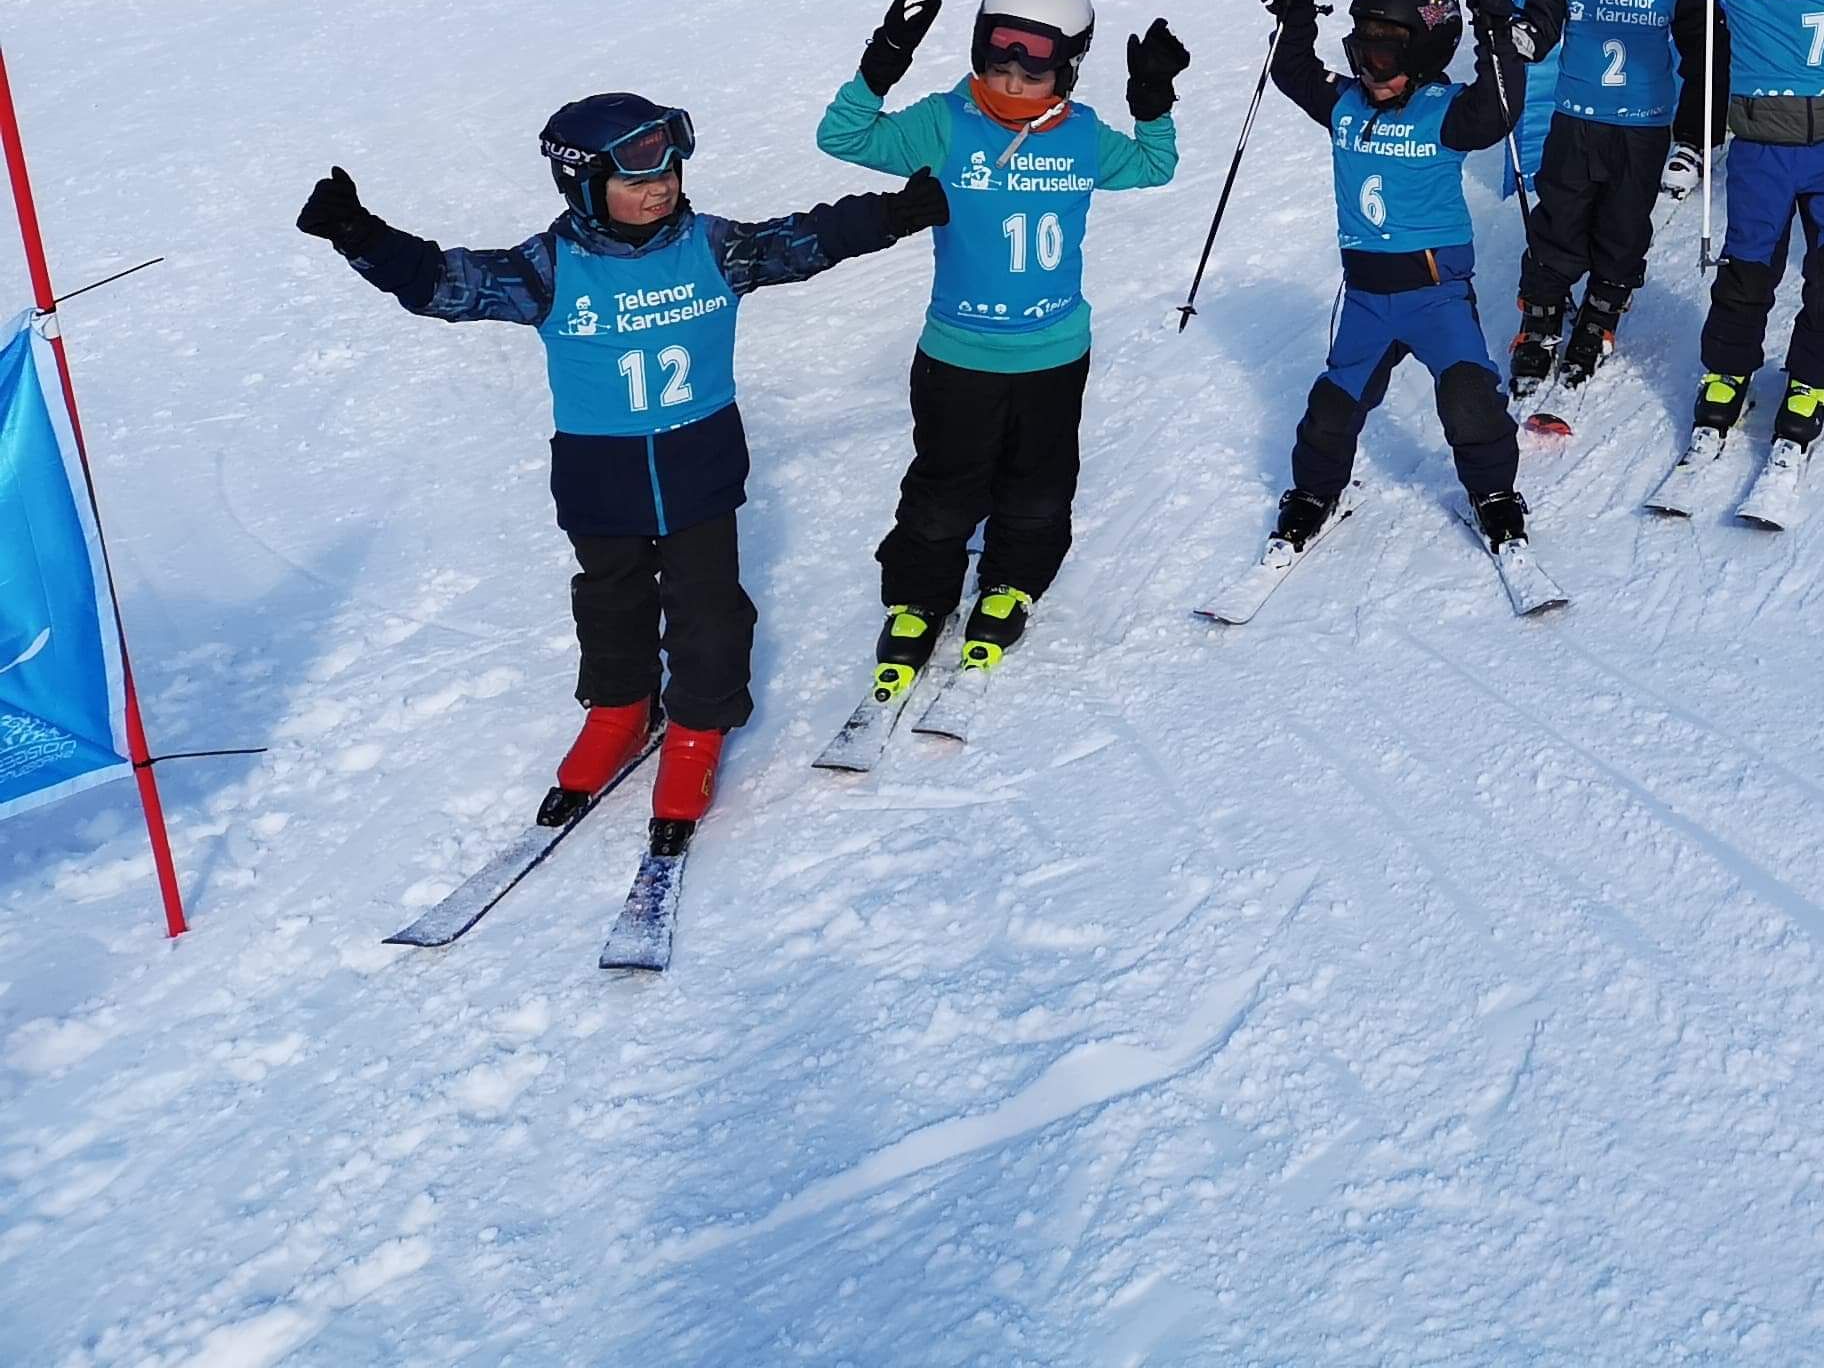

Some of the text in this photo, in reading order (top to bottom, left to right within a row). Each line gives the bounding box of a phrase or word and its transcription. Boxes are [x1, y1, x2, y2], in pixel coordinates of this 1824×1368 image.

[1602, 38, 1627, 87] 2
[1360, 119, 1415, 138] Tlenor
[1010, 153, 1075, 172] Telenor
[1353, 135, 1437, 158] Karusellen
[1007, 173, 1094, 192] Karusellen
[1360, 174, 1387, 228] 6
[1002, 212, 1063, 272] 10
[614, 282, 695, 313] Telenor
[616, 295, 728, 333] Karusellen
[617, 344, 693, 412] 12
